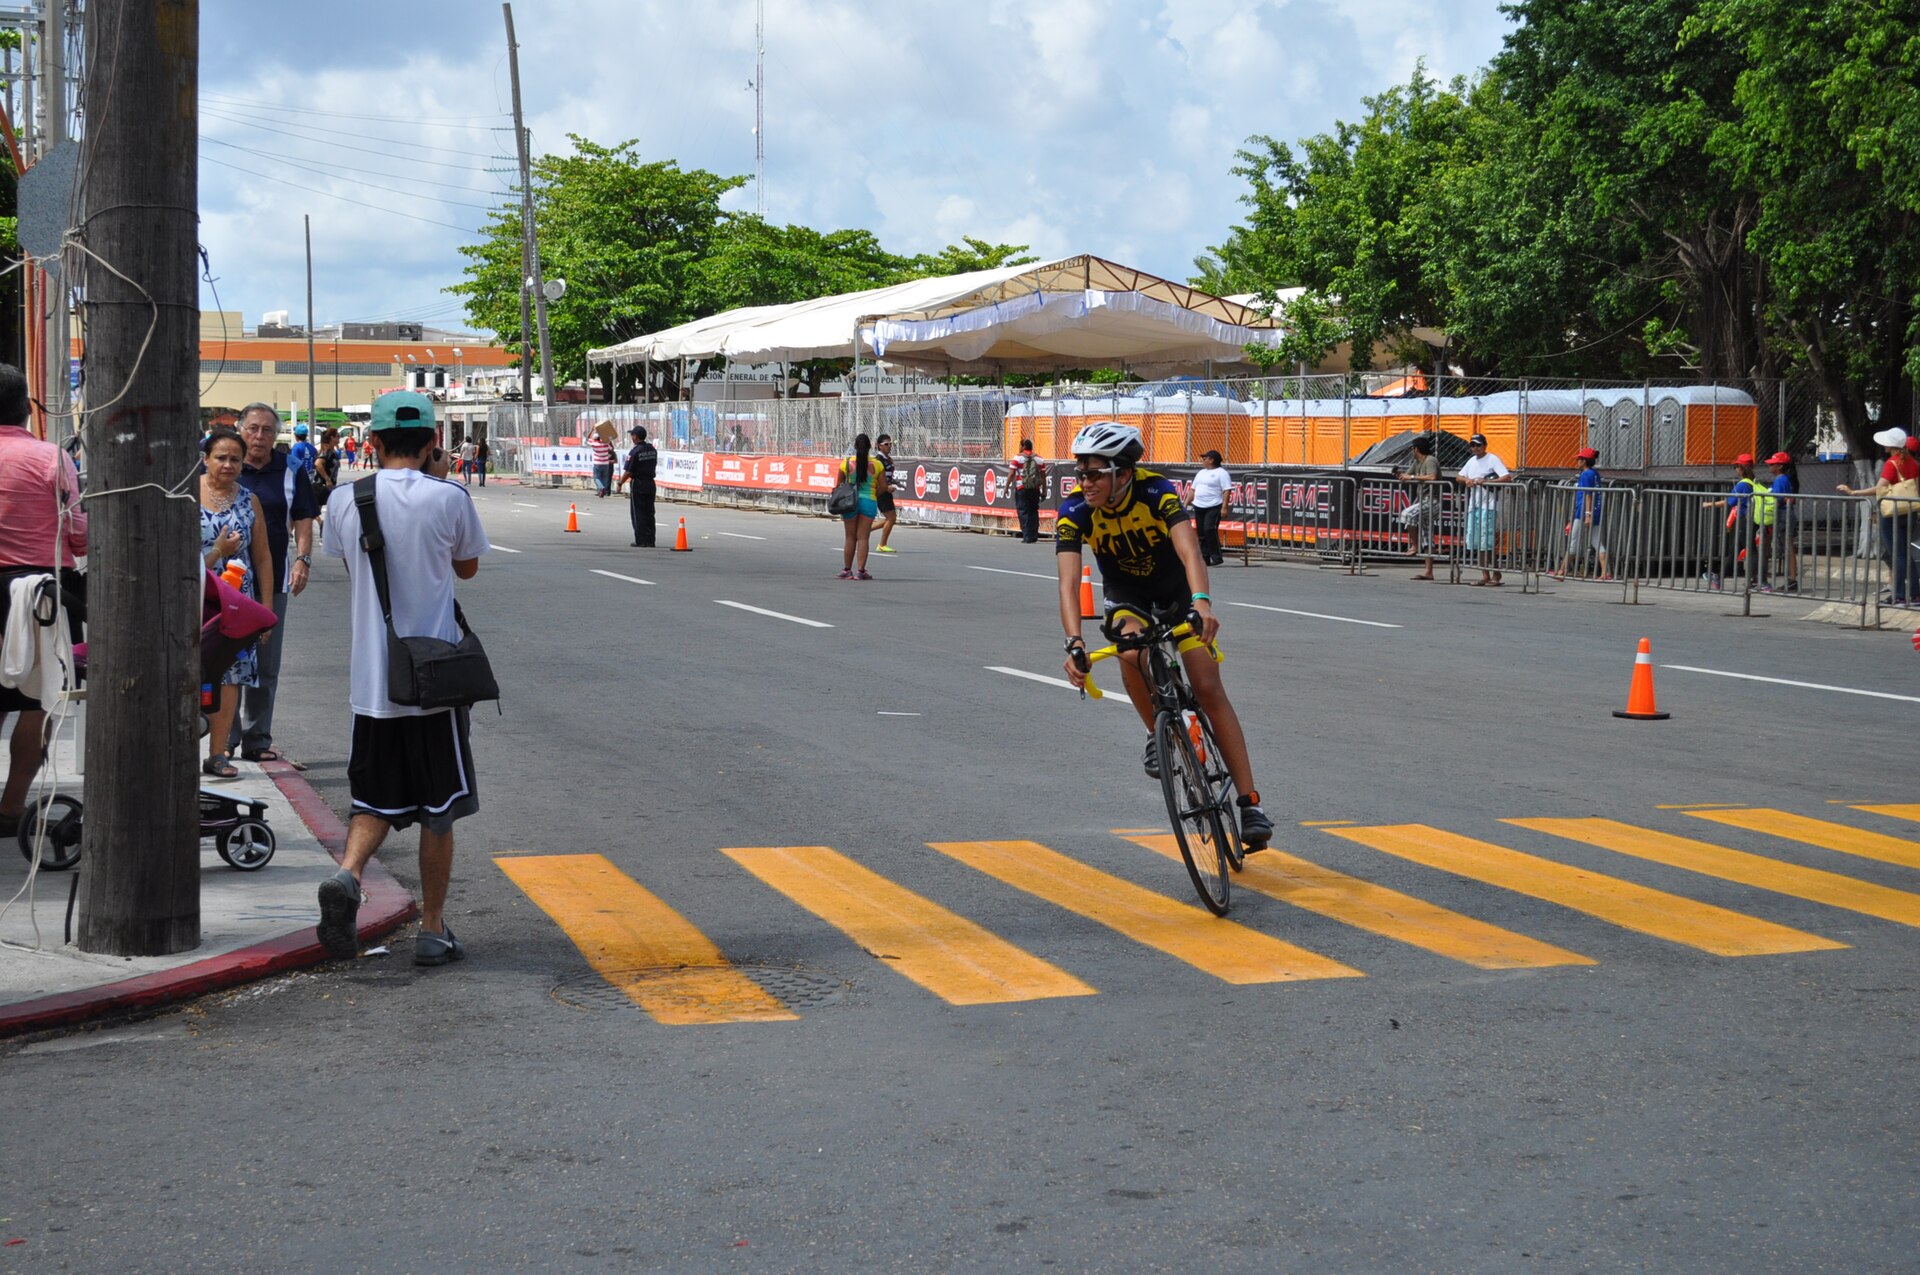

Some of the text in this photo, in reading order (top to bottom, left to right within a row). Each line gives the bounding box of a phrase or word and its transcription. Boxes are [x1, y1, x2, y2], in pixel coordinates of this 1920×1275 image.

[728, 372, 757, 381] ENERAL
[759, 373, 769, 381] DE
[926, 471, 942, 482] SPORTS
[959, 473, 977, 484] SPORTS
[926, 483, 940, 494] WORLD
[959, 485, 975, 496] WORLD
